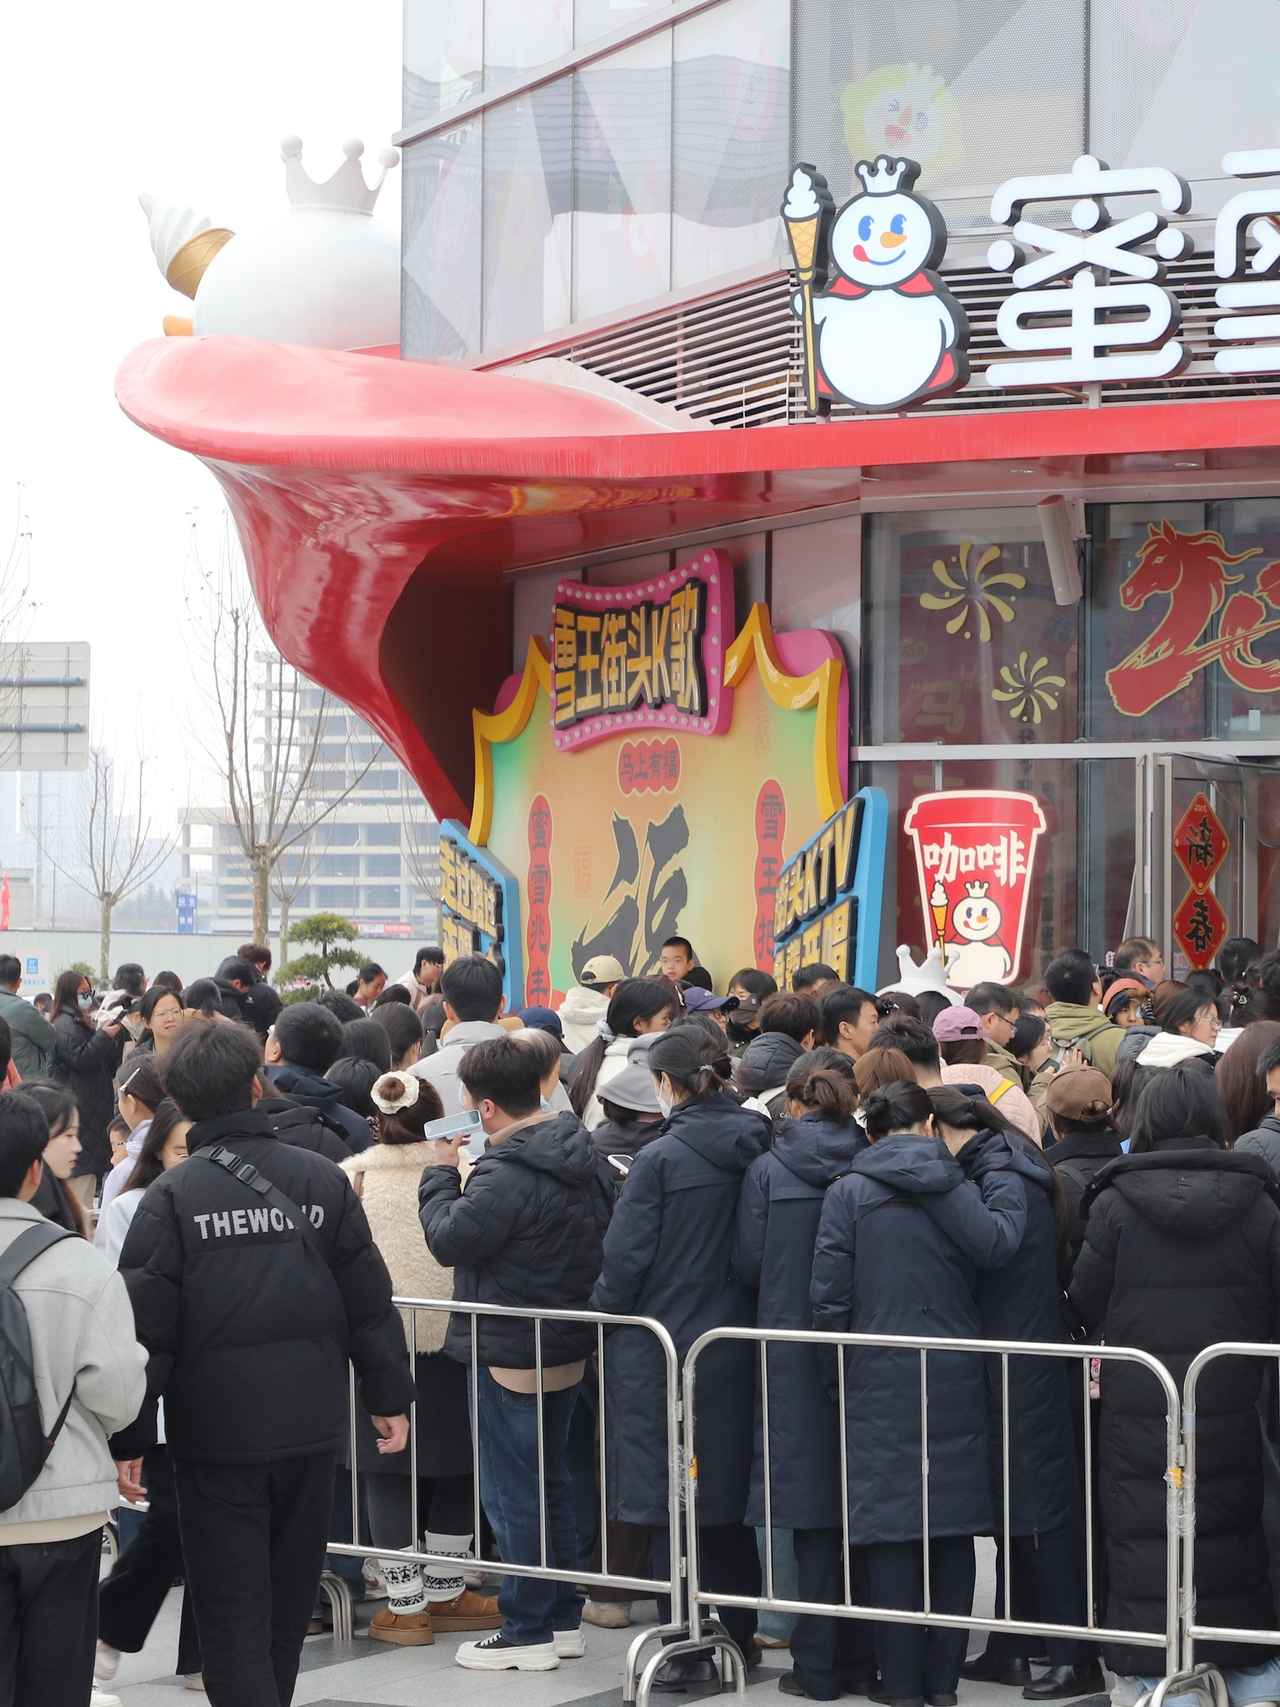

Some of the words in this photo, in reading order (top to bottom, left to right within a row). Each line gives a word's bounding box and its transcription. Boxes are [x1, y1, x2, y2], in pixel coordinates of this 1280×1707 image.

[555, 582, 699, 725] 雪王街头K歌
[620, 750, 678, 782] 马上有福
[923, 830, 1027, 888] 咖啡
[193, 1204, 325, 1240] THEWOD
